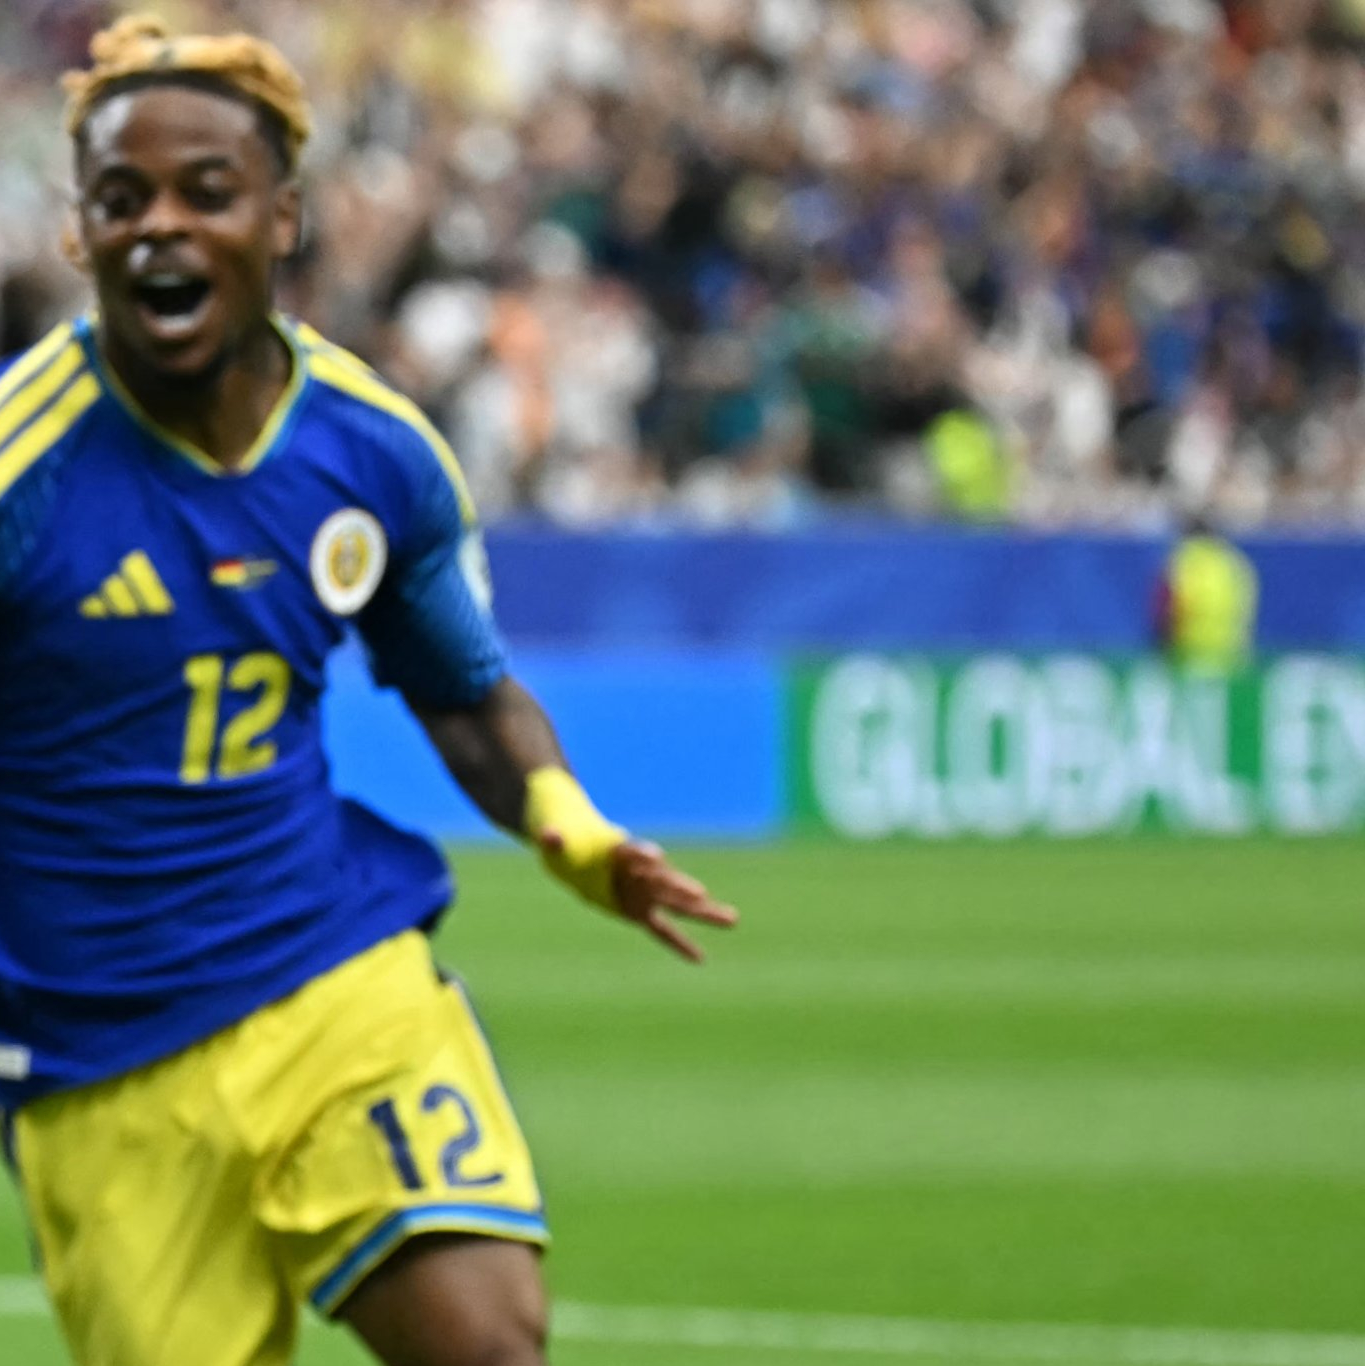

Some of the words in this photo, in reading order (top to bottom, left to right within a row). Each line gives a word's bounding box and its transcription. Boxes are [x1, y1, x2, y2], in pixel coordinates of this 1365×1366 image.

[180, 651, 290, 785] 12
[809, 655, 1259, 838] GLOBAL
[368, 1084, 504, 1191] 12
